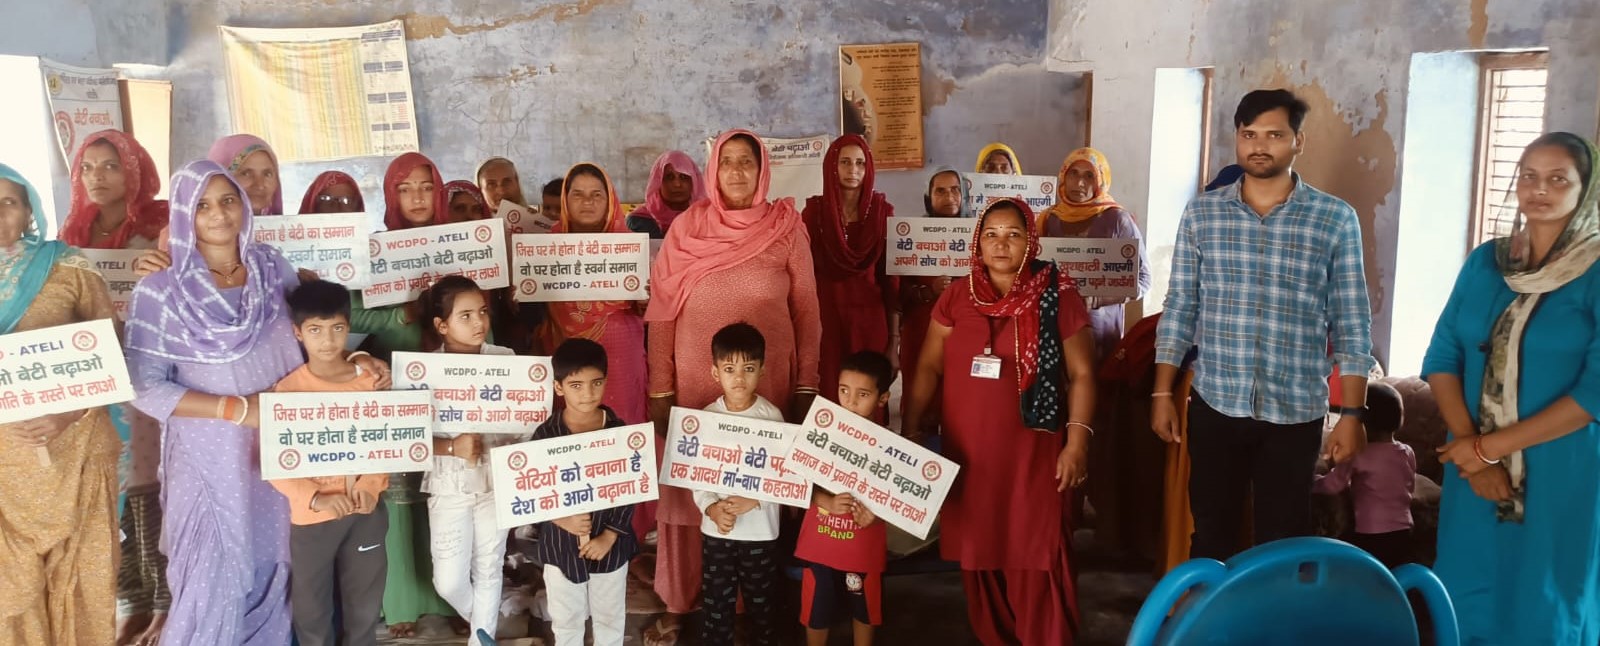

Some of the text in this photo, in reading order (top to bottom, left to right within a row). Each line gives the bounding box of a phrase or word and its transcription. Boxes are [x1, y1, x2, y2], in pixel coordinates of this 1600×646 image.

[278, 223, 285, 242] है
[287, 223, 305, 240] बेटी
[307, 227, 321, 239] का
[322, 226, 355, 239] सम्मान
[385, 237, 428, 250] WCDPO
[438, 232, 469, 243] ATELI
[286, 245, 314, 262] स्वर्ग
[317, 248, 352, 261] समान
[516, 242, 534, 257] जिस
[536, 244, 548, 256] घर
[558, 241, 575, 256] होता
[577, 241, 584, 256] है
[585, 240, 599, 254] बेटी
[601, 243, 613, 253] का
[614, 242, 641, 254] सम्मान
[896, 238, 913, 250] बेटी
[915, 239, 947, 251] बचाओ
[949, 239, 966, 252] बेटी
[391, 253, 430, 270] बचाओ
[433, 249, 454, 265] बेटी
[457, 245, 493, 265] बढ़ाओ
[520, 259, 638, 277] वो घर होता है स्वर्ग समान
[894, 254, 918, 266] अपनी
[920, 254, 937, 266] सोच
[938, 255, 951, 266] को
[393, 276, 406, 291] को
[478, 263, 500, 280] लाओ
[542, 281, 581, 290] WCDPO
[590, 280, 619, 289] ATELI
[20, 340, 64, 356] ATELI
[16, 362, 47, 381] बेटी
[51, 353, 103, 378] बढ़ाओ
[444, 368, 477, 376] WCDPO
[485, 368, 511, 377] ATELI
[20, 389, 35, 405] के
[38, 384, 66, 403] रास्ते
[67, 384, 85, 398] पर
[86, 374, 117, 395] लाओ
[433, 384, 546, 406] बचाओ बेटी बढ़ाओ
[273, 403, 297, 421] जिस
[299, 406, 314, 421] घर
[328, 402, 350, 421] होता
[352, 402, 360, 420] है
[362, 400, 379, 419] बेटी
[381, 405, 395, 417] का
[397, 403, 429, 417] सम्मान
[439, 406, 463, 422] सोच
[466, 406, 483, 422] को
[485, 407, 511, 423] आगे
[514, 405, 548, 426] बढ़ाओ
[279, 423, 425, 446] वो घर होता है स्वर्ग समान
[718, 422, 750, 435] WCDPO
[757, 429, 783, 440] ATELI
[547, 444, 582, 456] WCDPO
[589, 438, 616, 449] ATELI
[677, 435, 700, 457] बेटी
[702, 445, 743, 464] बचाओ
[744, 446, 767, 469] बेटी
[837, 421, 877, 447] WCDPO
[884, 446, 919, 467] ATELI
[308, 452, 356, 463] WCDPO
[368, 449, 403, 460] ATELI
[806, 428, 932, 500] बेटी बचाओ बेटी बढ़ाओ
[514, 450, 642, 491] बेटियों को बचाना है
[670, 462, 690, 479] एक
[690, 464, 723, 485] आदर्श
[762, 478, 808, 500] कहलाओ
[511, 472, 650, 516] देश को आगे बढ़ाना है
[791, 447, 928, 525] समाज को प्रगति के रास्ते पर लाओ
[817, 525, 855, 540] BRAND
